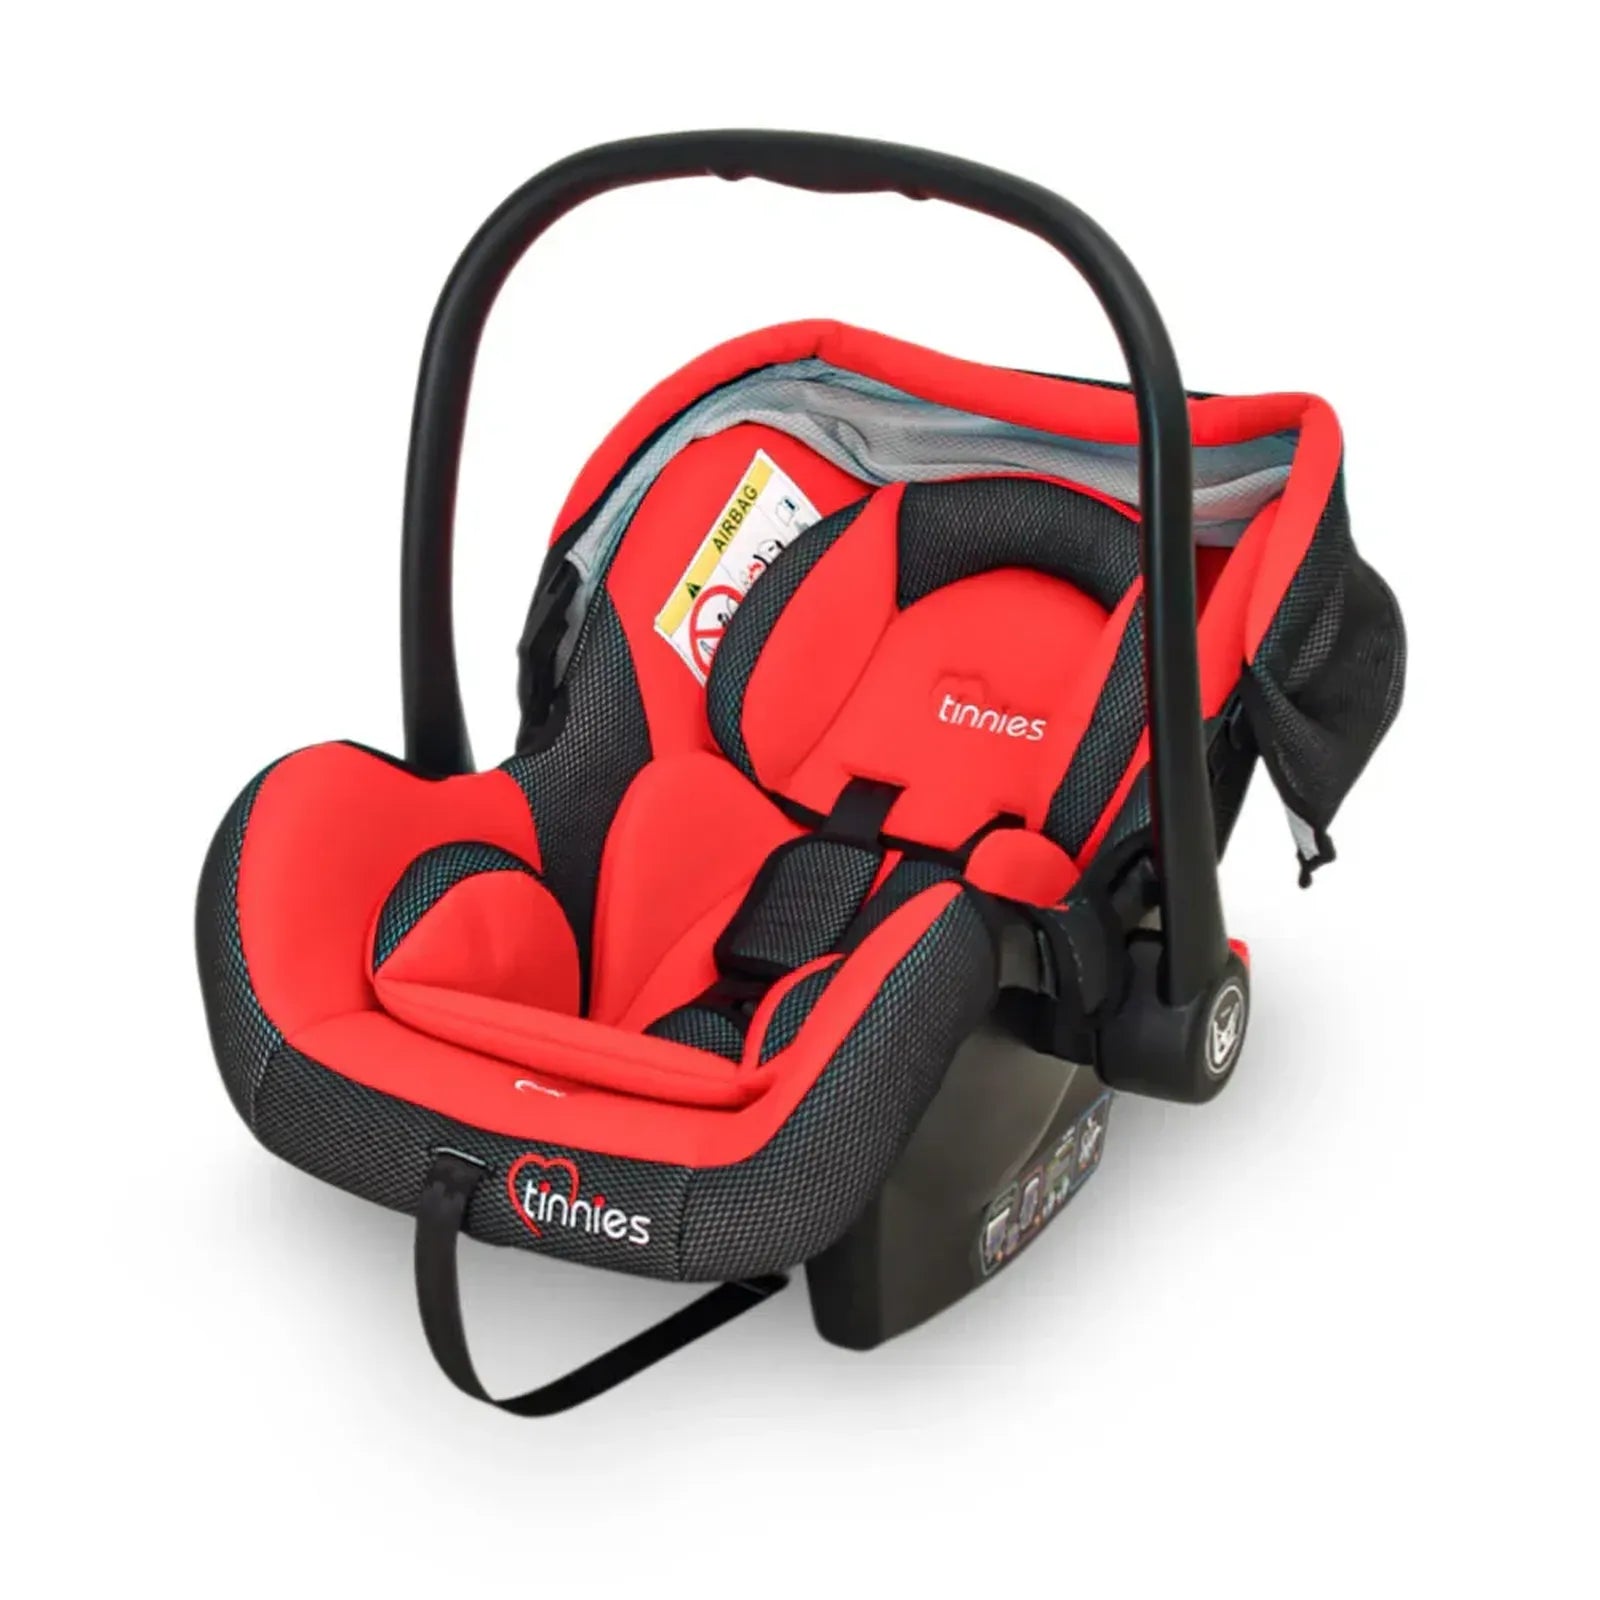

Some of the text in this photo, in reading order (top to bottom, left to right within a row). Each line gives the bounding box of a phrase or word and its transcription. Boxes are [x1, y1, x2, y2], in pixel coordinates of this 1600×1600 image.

[712, 485, 758, 553] AIRBAG
[938, 694, 1047, 741] tinnies
[523, 1180, 651, 1244] tinnies
